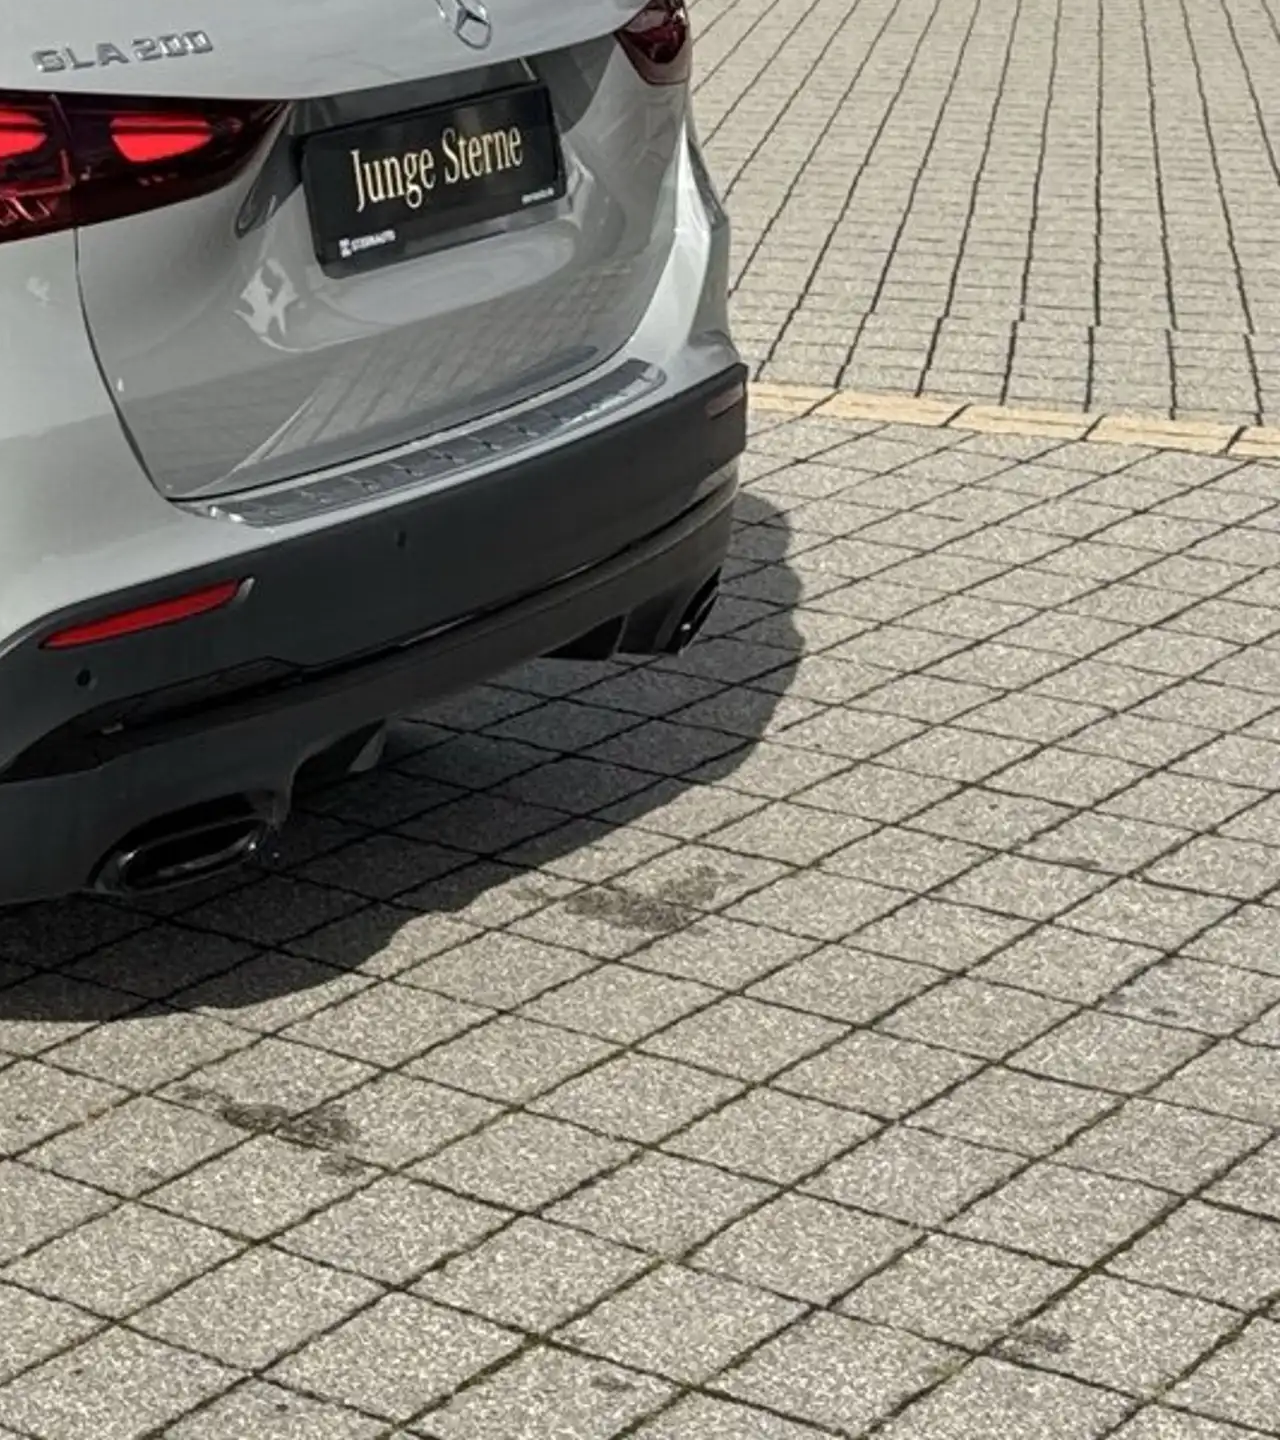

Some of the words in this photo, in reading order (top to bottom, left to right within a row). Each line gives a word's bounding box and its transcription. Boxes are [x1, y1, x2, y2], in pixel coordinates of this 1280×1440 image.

[32, 41, 130, 73] GLA
[131, 30, 214, 61] 200
[349, 147, 436, 213] Junge
[441, 126, 524, 185] Sterne
